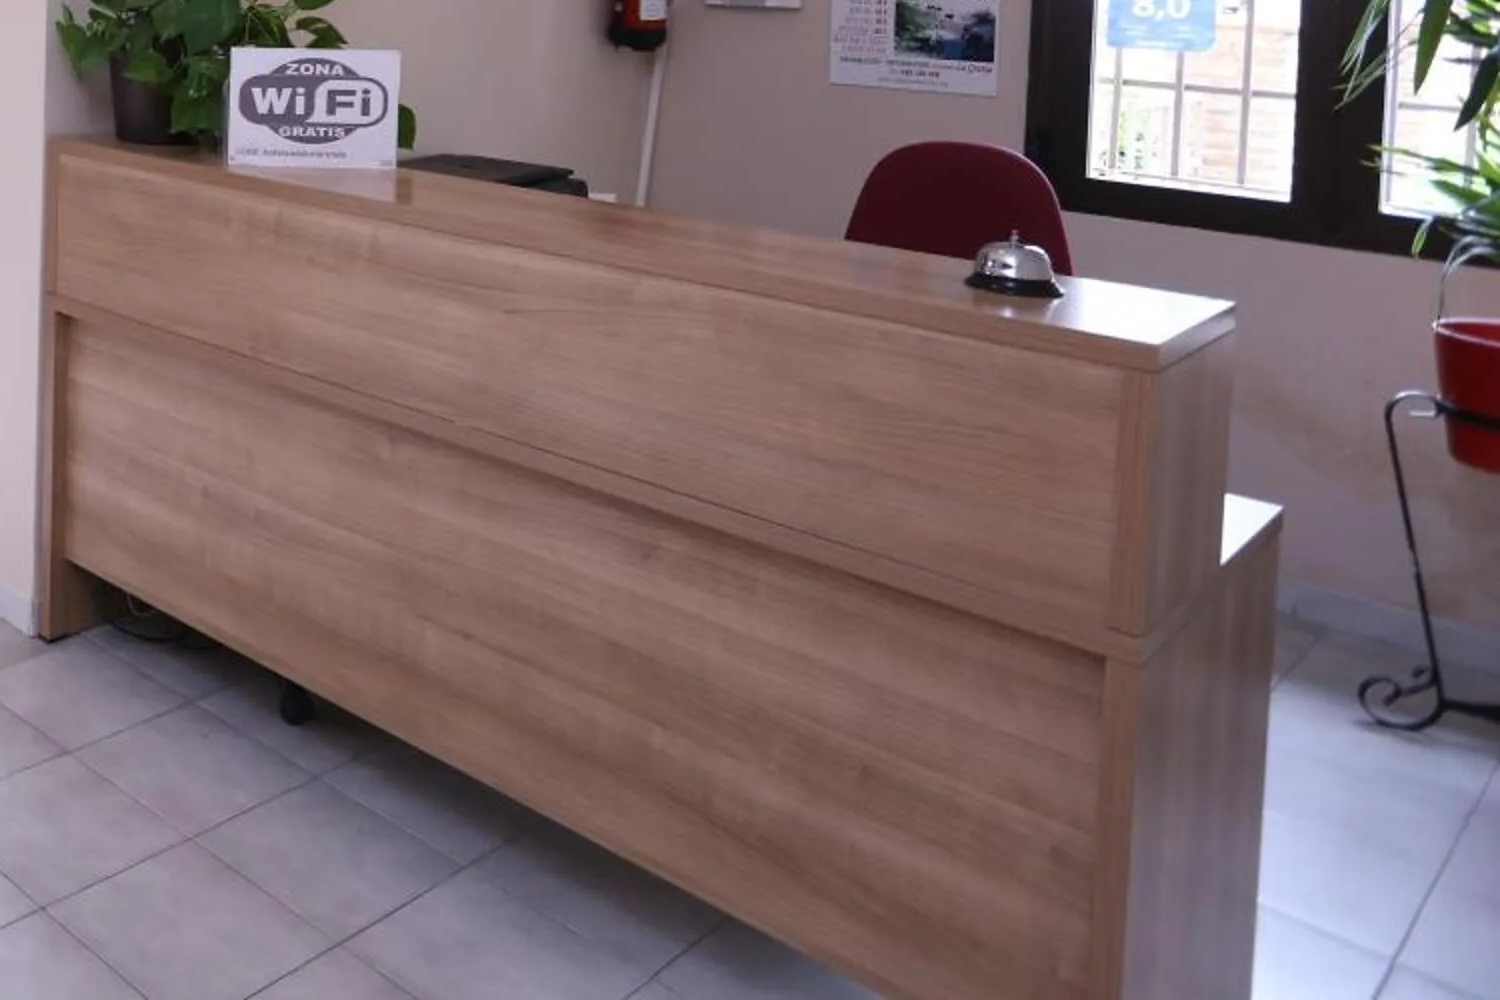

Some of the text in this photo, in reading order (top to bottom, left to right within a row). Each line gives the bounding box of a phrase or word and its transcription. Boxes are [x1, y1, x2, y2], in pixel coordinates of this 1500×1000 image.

[286, 63, 345, 76] ZONA
[252, 87, 372, 116] WiFi
[278, 126, 347, 138] GRATIS
